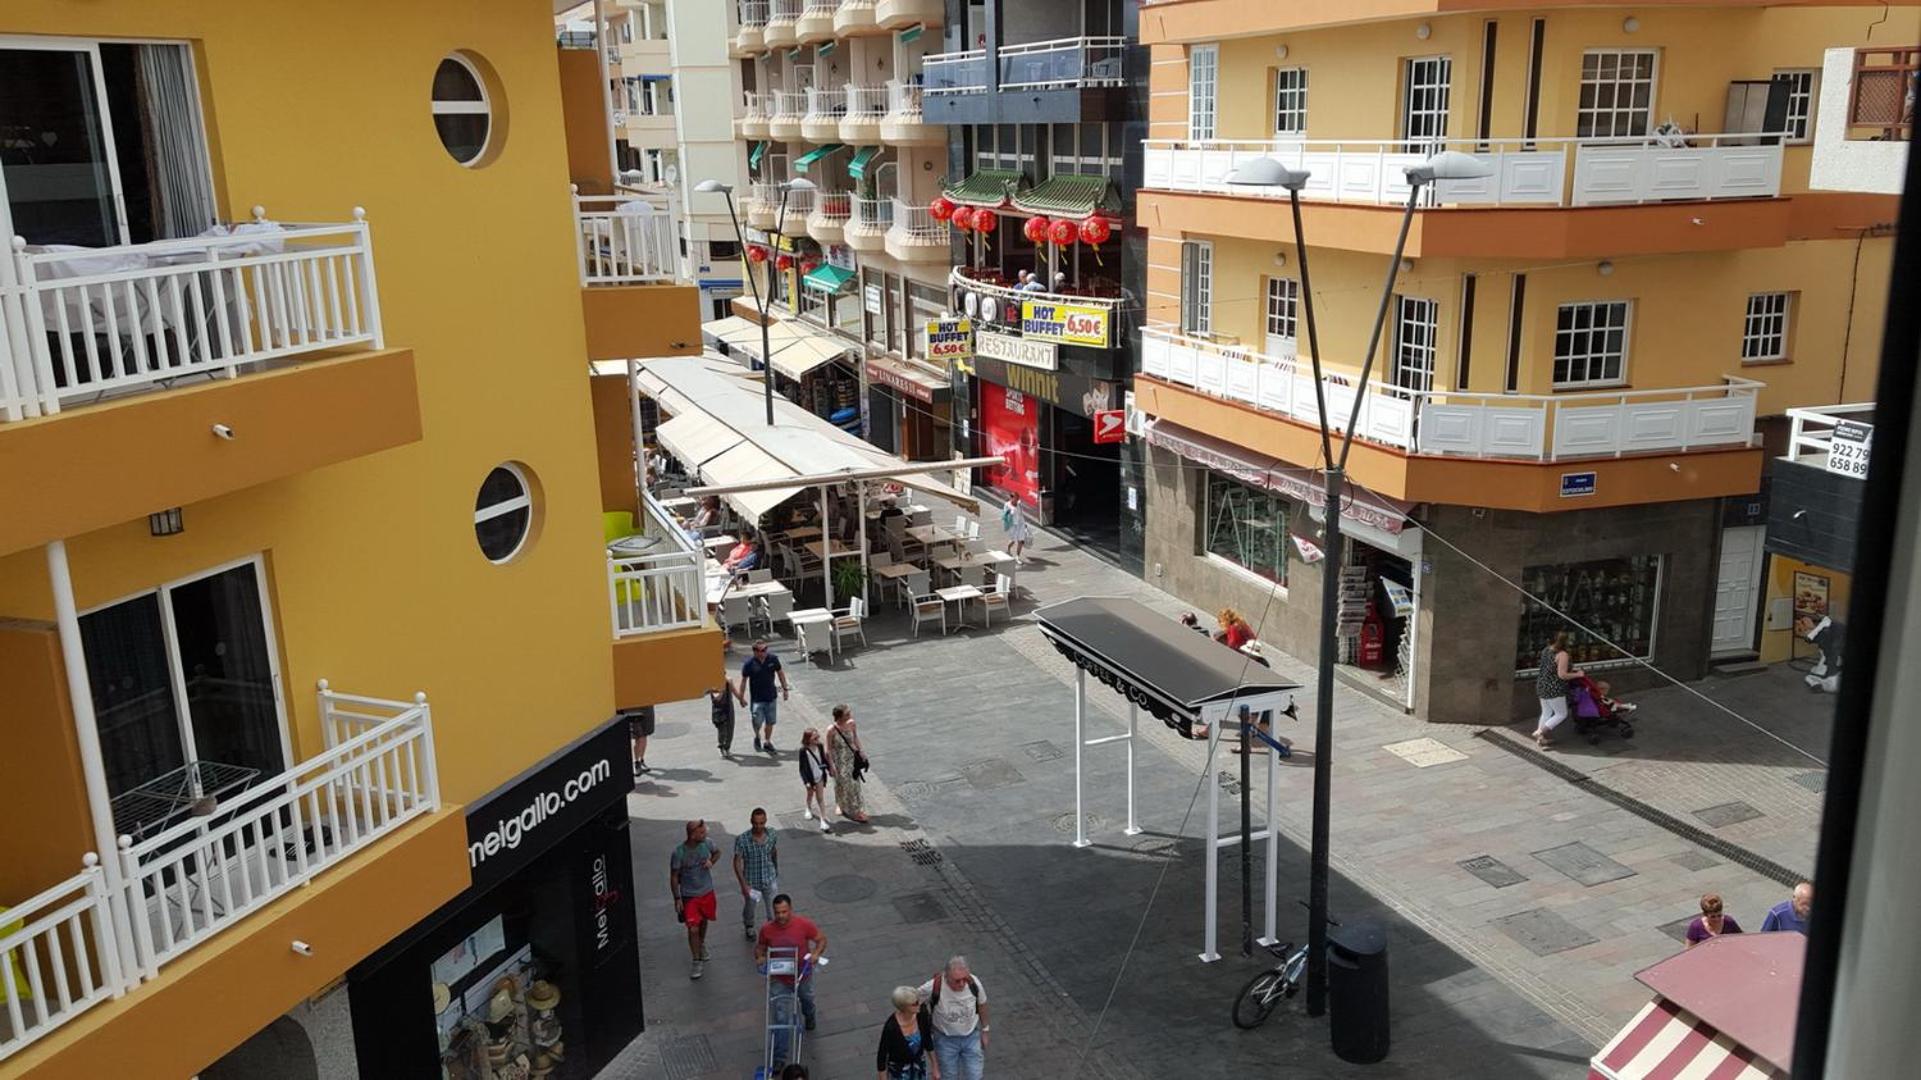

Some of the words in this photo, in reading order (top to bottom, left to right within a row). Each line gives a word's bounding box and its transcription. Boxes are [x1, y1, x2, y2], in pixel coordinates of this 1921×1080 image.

[1033, 306, 1055, 320] HOT
[938, 322, 959, 332] HOT
[1024, 321, 1065, 336] BUFFET
[929, 332, 969, 343] BUFFET
[977, 334, 1055, 366] RESTAURANT
[1832, 442, 1853, 458] 922
[1829, 456, 1851, 472] 658
[1852, 461, 1867, 475] 89
